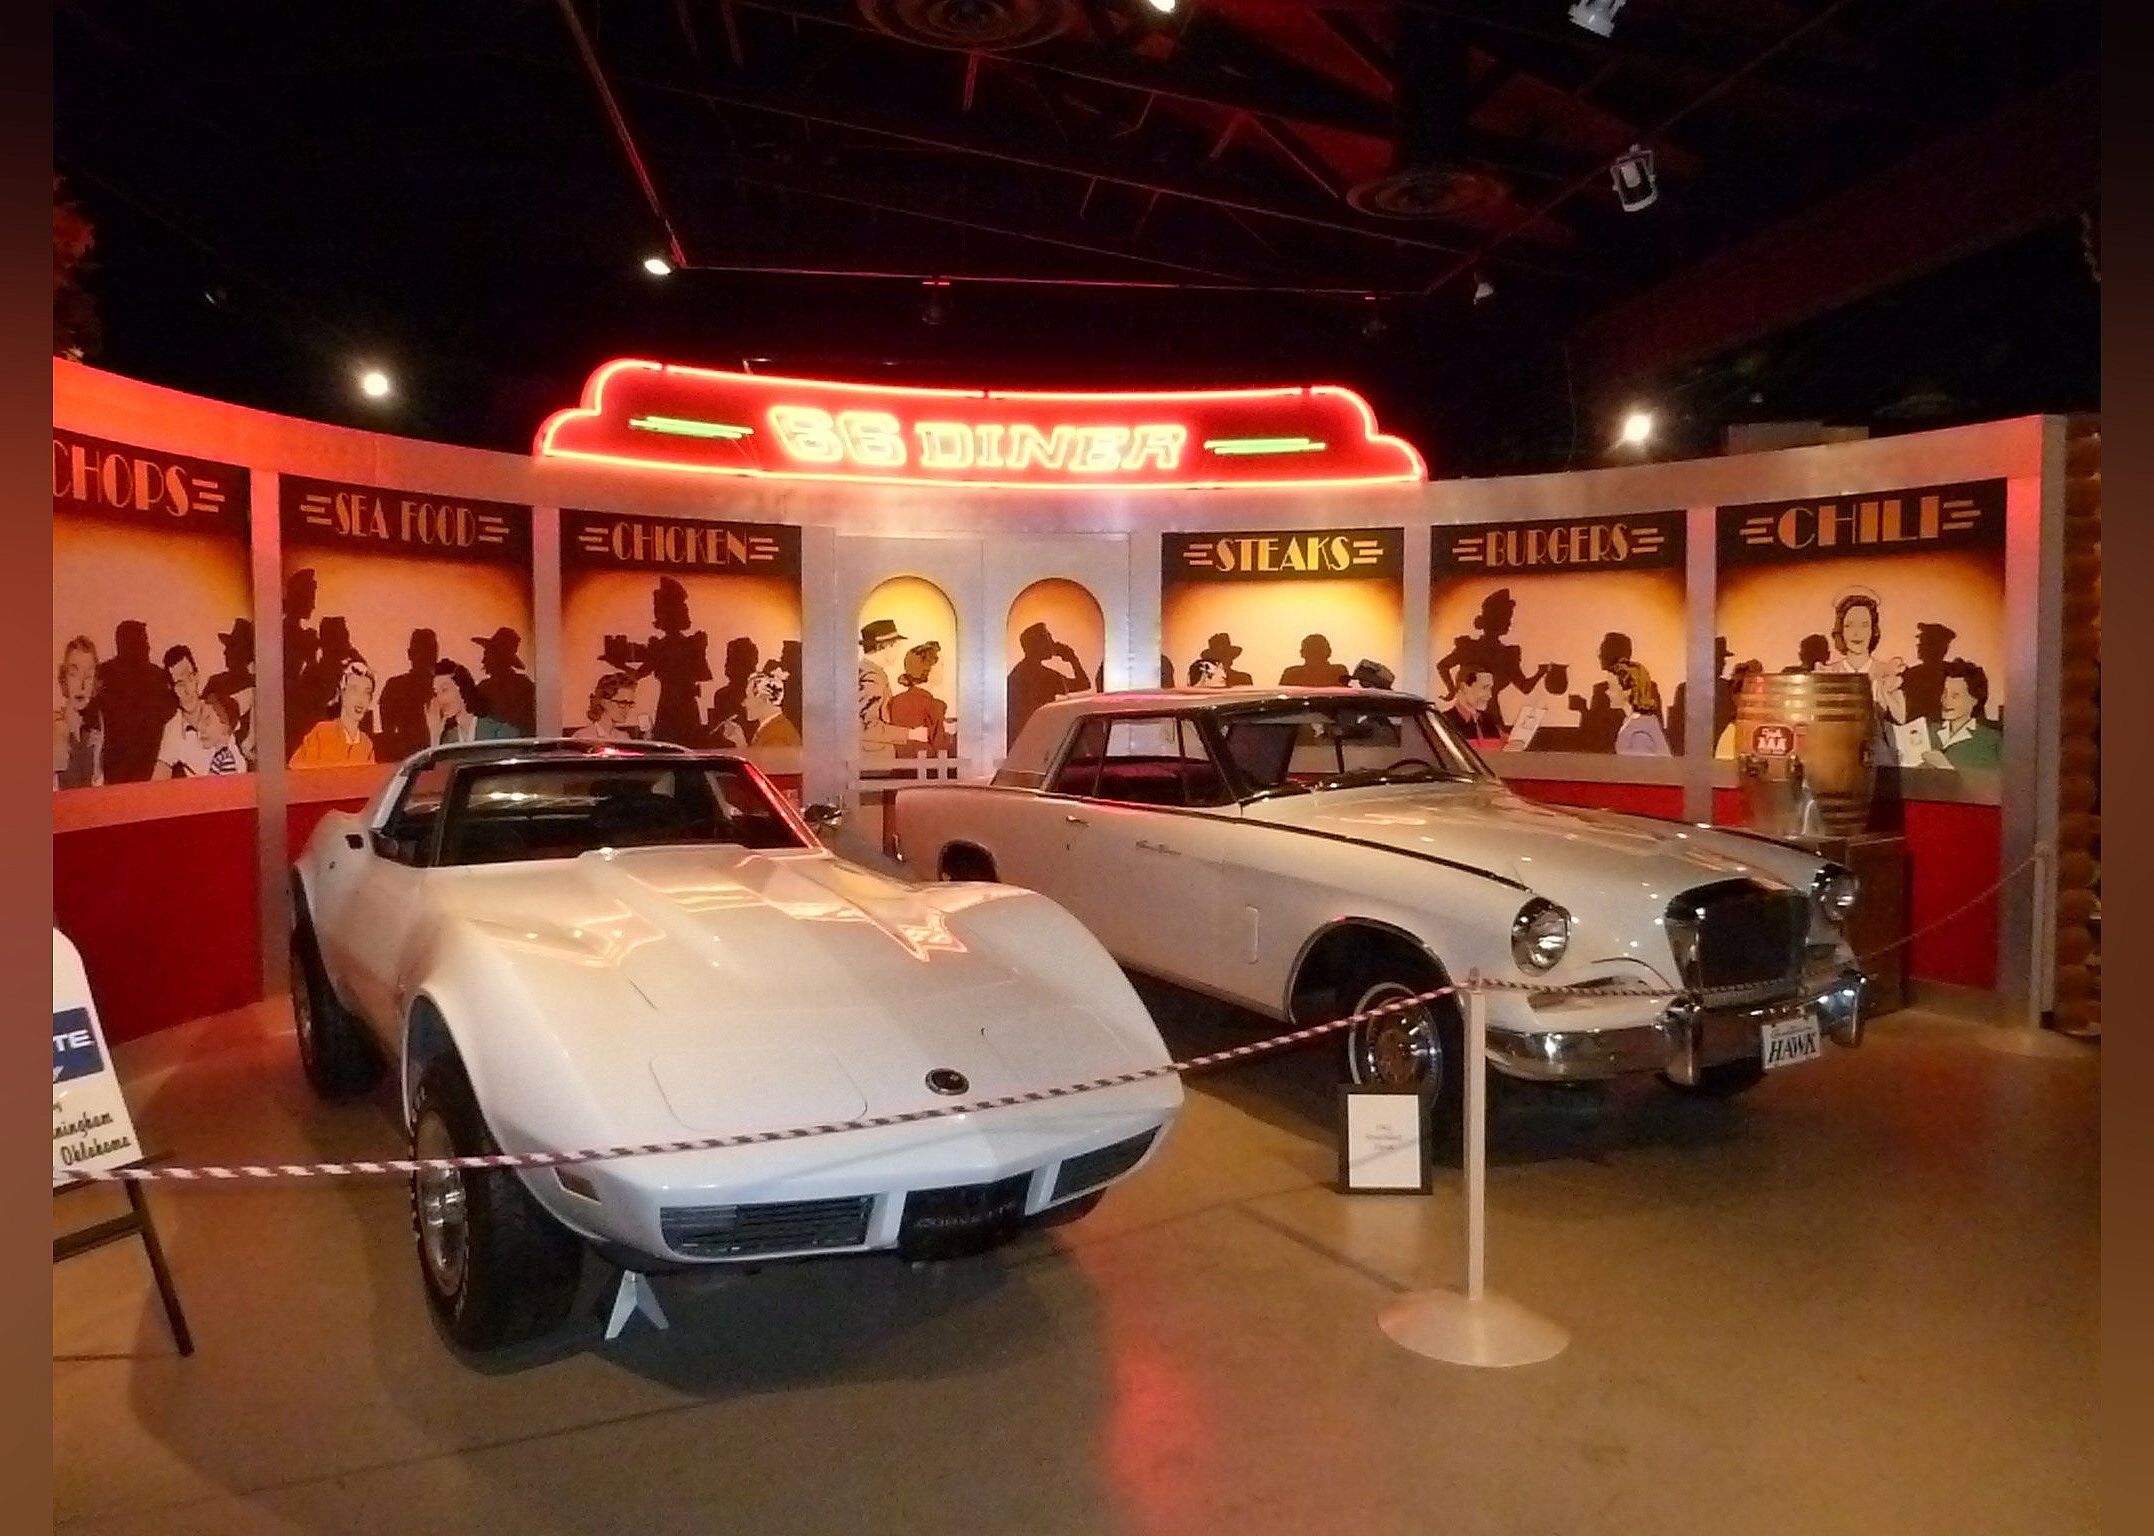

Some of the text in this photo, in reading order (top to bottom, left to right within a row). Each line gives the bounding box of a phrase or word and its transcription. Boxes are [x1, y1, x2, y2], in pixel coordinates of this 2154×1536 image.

[768, 405, 1188, 472] 66 DINER
[335, 492, 476, 547] SEA FOOD
[1777, 496, 1940, 549] CHILI
[612, 521, 748, 565] CHICKEN
[1215, 535, 1350, 572] STEAKS
[1486, 523, 1629, 567] BURGERS
[1768, 1032, 1817, 1063] HAWK
[60, 1136, 131, 1166] Oklahoma
